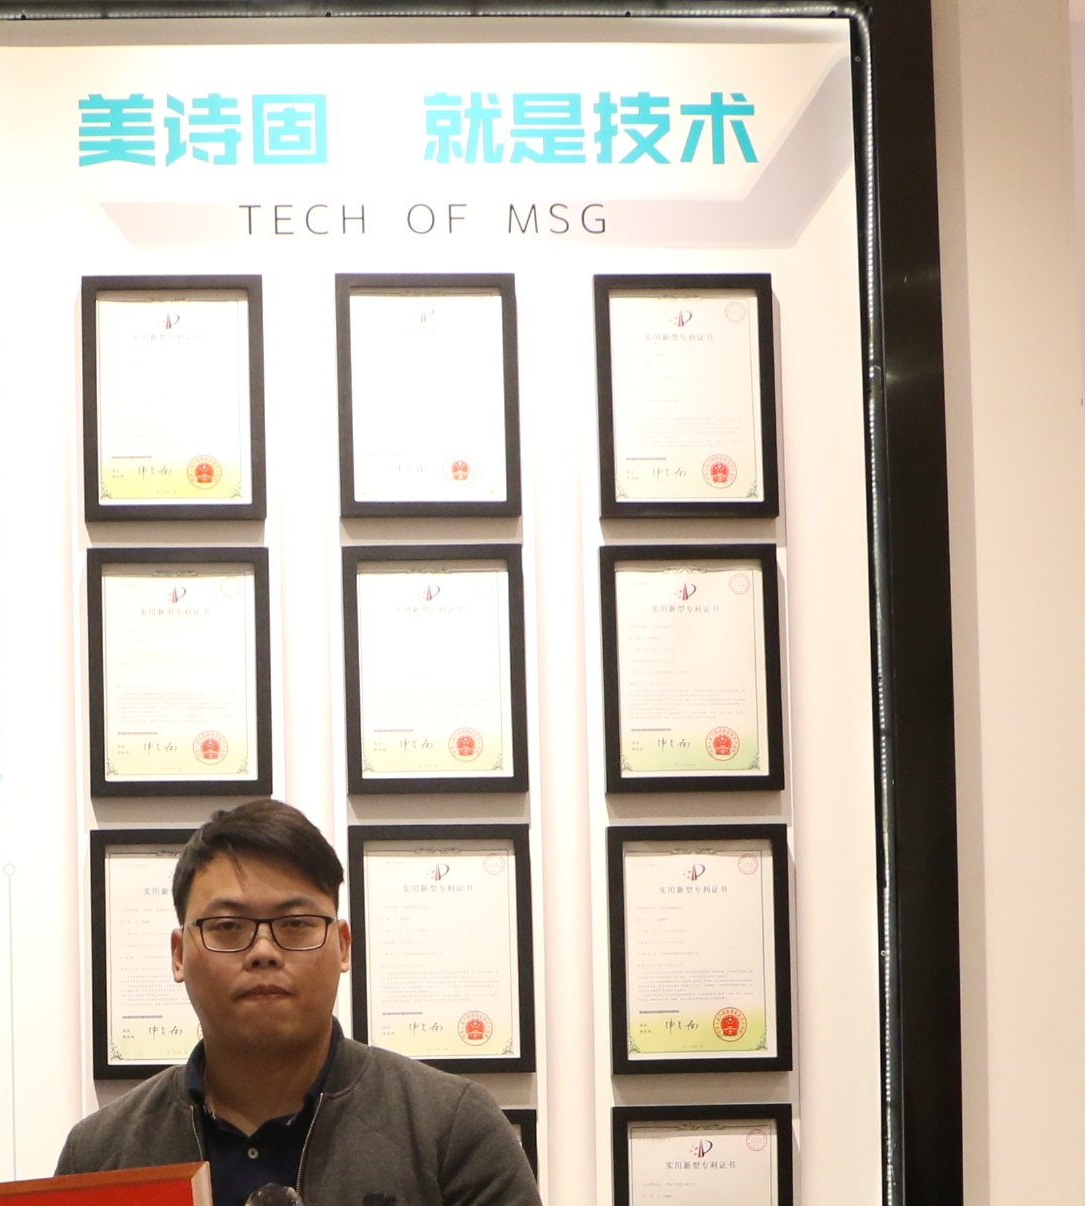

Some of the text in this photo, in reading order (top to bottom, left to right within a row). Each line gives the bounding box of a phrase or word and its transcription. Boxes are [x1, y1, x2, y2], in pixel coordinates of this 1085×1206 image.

[78, 91, 760, 168] 美诗固 就是技术
[238, 203, 607, 236] TECH OF MSG
